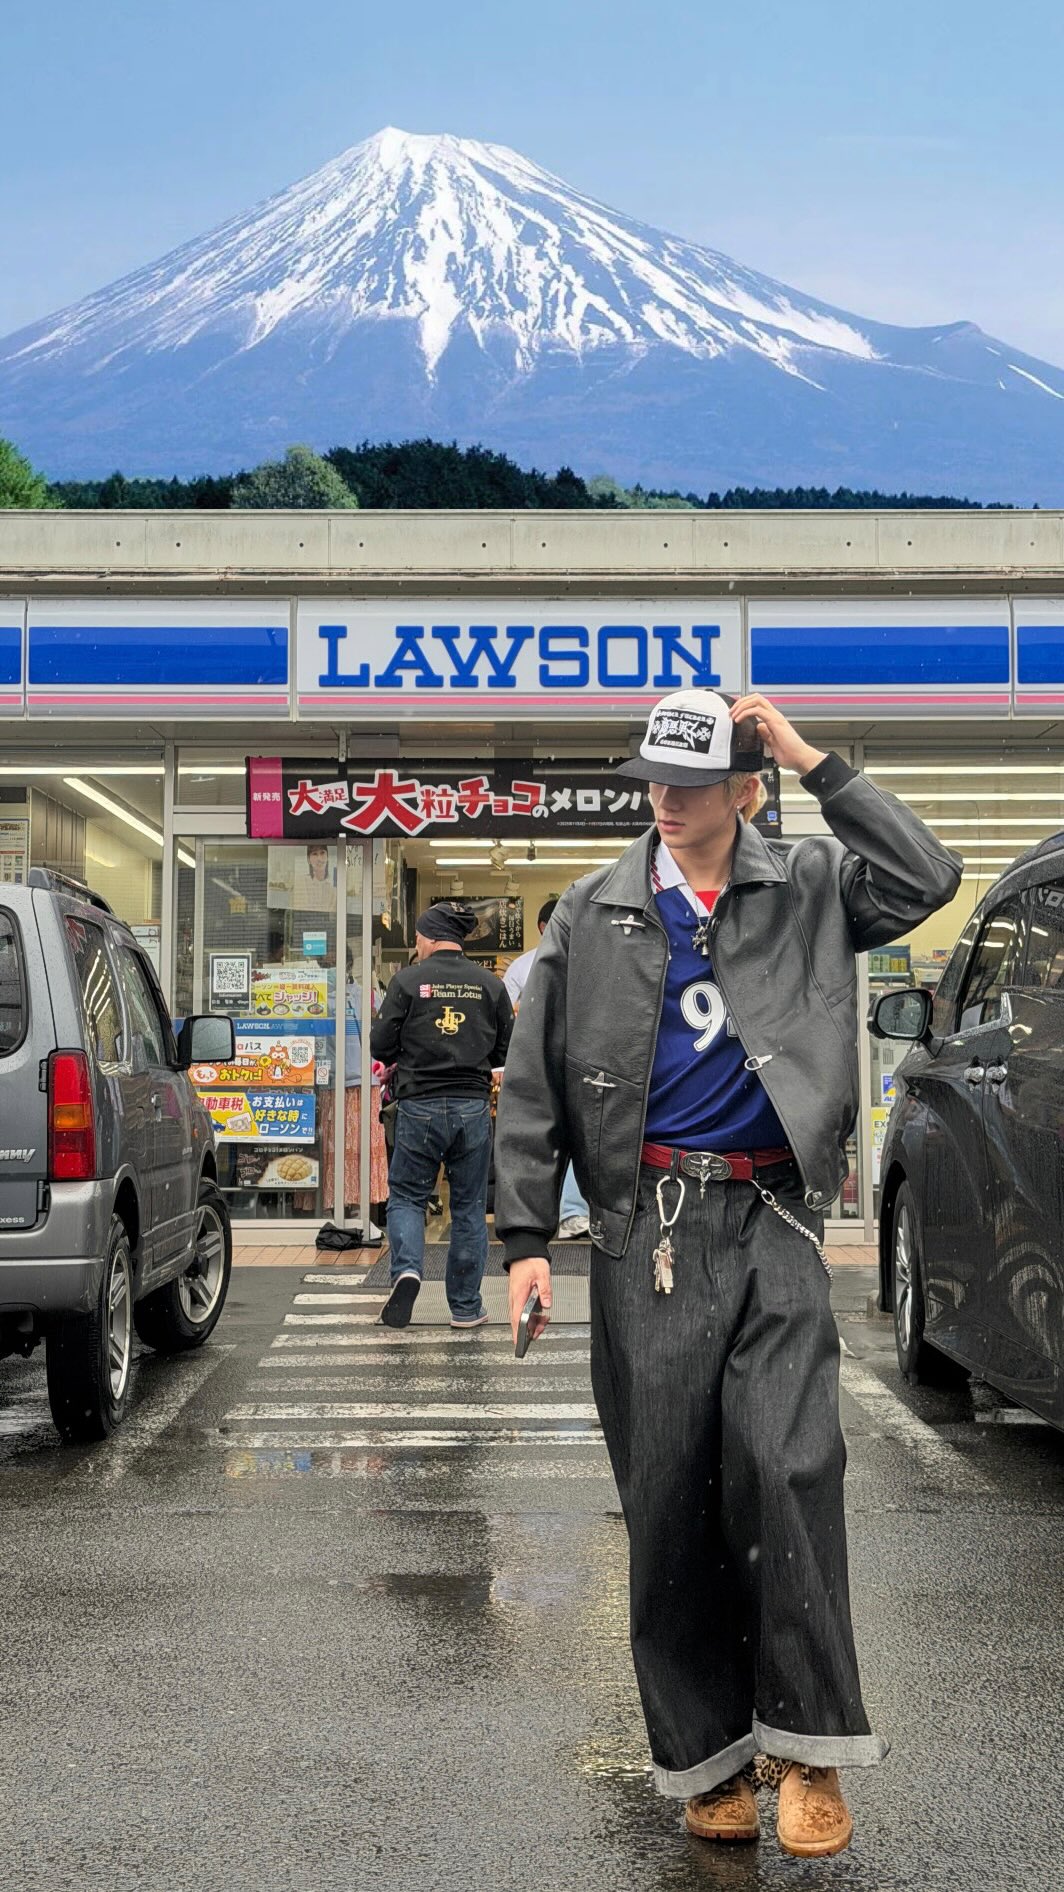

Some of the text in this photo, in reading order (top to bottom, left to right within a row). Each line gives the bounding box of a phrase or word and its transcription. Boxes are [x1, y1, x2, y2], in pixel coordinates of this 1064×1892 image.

[319, 625, 721, 687] LAWSON
[253, 792, 281, 802] 新発売
[289, 781, 348, 814] 大満足
[432, 989, 482, 1000] Team Lotus
[196, 1069, 215, 1080] もっと
[201, 1097, 244, 1111] 動車税
